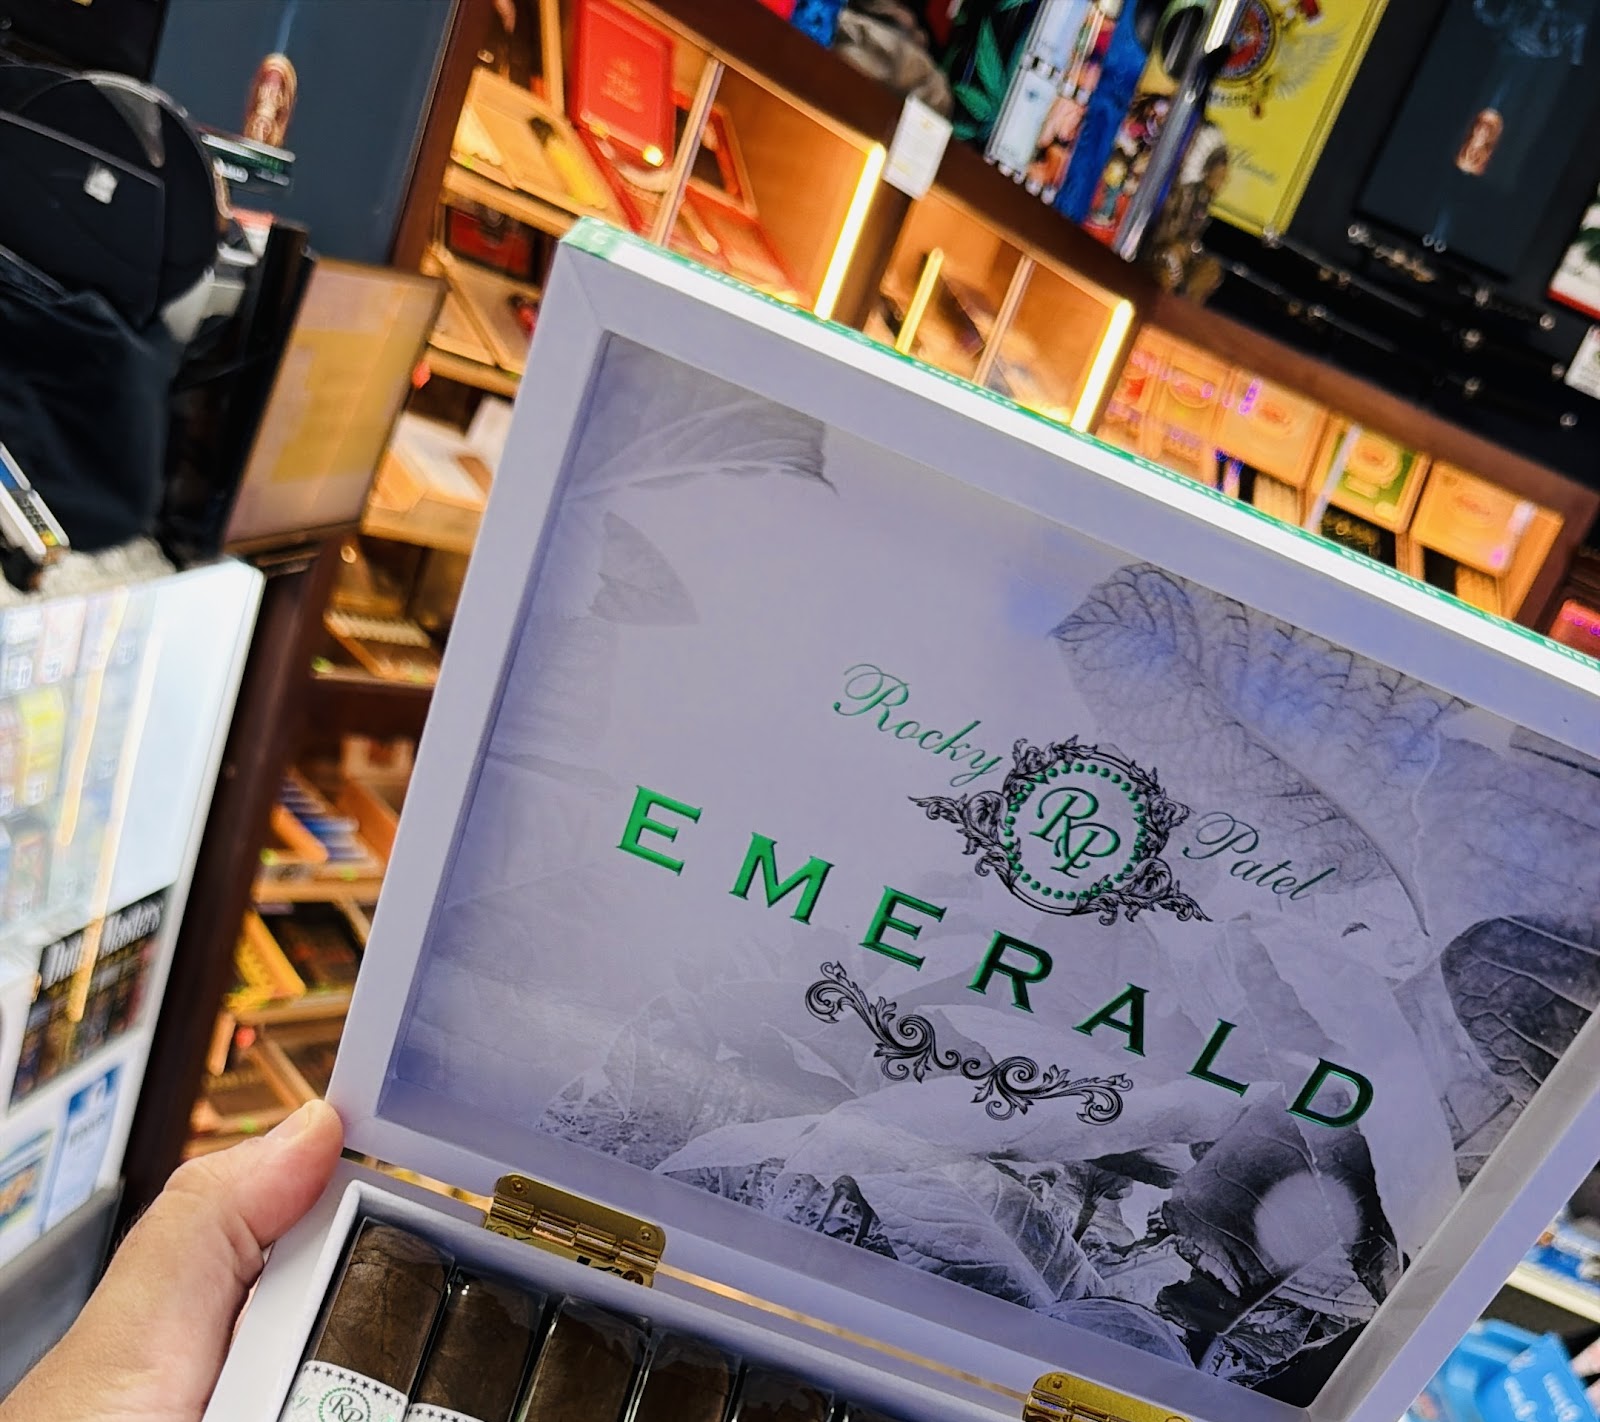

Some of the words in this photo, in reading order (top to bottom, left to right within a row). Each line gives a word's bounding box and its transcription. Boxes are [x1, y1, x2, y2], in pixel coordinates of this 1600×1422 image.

[1340, 548, 1441, 598] EMERALD
[834, 663, 1004, 787] Rocky
[1032, 786, 1120, 879] RP
[1182, 811, 1338, 902] Patel
[615, 785, 1375, 1129] EMERALD
